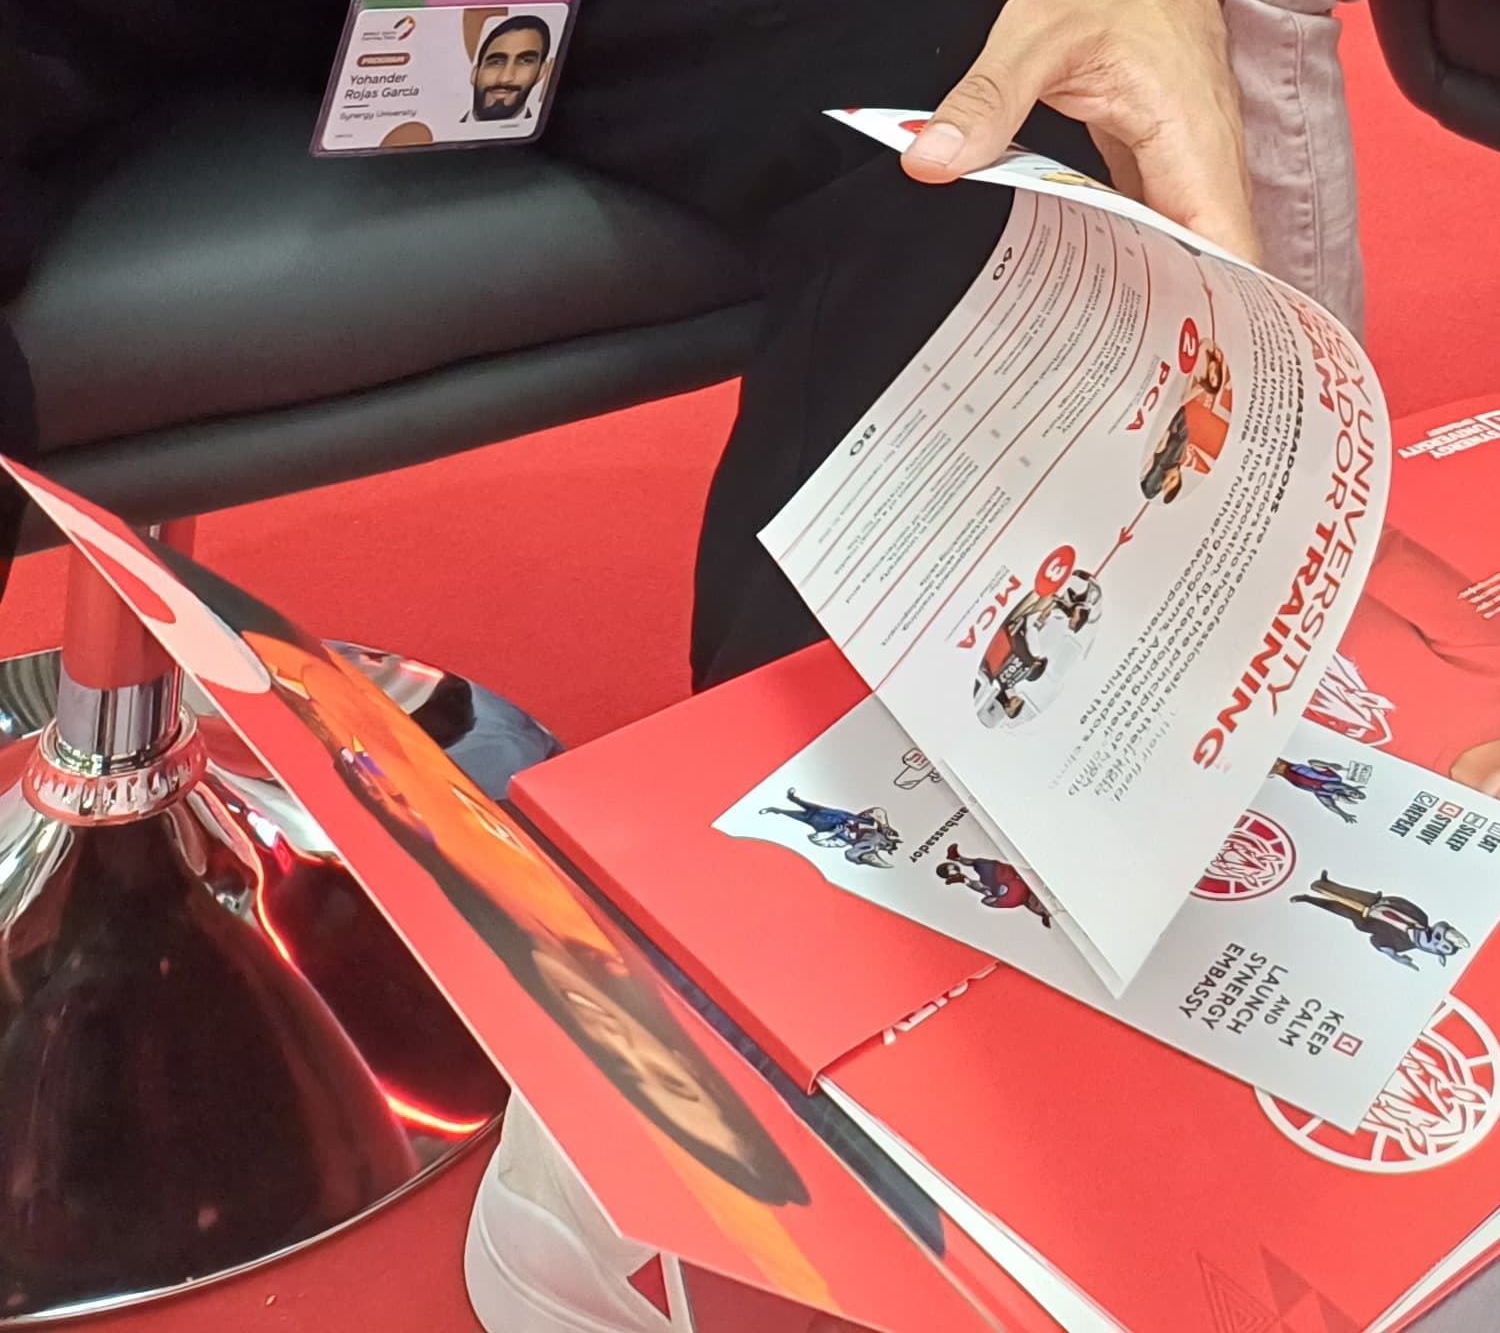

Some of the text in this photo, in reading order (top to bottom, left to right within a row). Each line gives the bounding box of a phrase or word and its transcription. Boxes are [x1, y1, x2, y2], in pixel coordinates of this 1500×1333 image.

[343, 86, 378, 102] Rojas
[349, 70, 408, 87] Yohander
[1180, 331, 1197, 356] 2
[1125, 361, 1170, 430] PCA
[1268, 354, 1305, 513] AMBASSADORS
[1041, 553, 1070, 585] 3
[1136, 535, 1211, 645] development
[1191, 580, 1212, 606] By
[1266, 408, 1375, 716] UNIVERSITY
[955, 574, 1022, 647] MCA
[1162, 584, 1237, 695] professionals
[1128, 605, 1197, 697] developing
[1192, 520, 1336, 770] TRAINING
[1080, 634, 1162, 743] Ambassadors
[1123, 647, 1184, 730] principles
[908, 805, 969, 863] ambassador
[1388, 802, 1427, 838] REPEAT
[1414, 813, 1452, 846] STUDY
[1444, 823, 1477, 852] SLEEP
[1477, 834, 1500, 854] EAT
[1178, 941, 1245, 1018] EMBASSY
[1200, 952, 1268, 1030] SYNERGY
[1225, 963, 1288, 1034] LAUNCH
[1264, 993, 1291, 1023] AND
[1277, 997, 1323, 1047] CALM
[1304, 1009, 1344, 1057] KEEP
